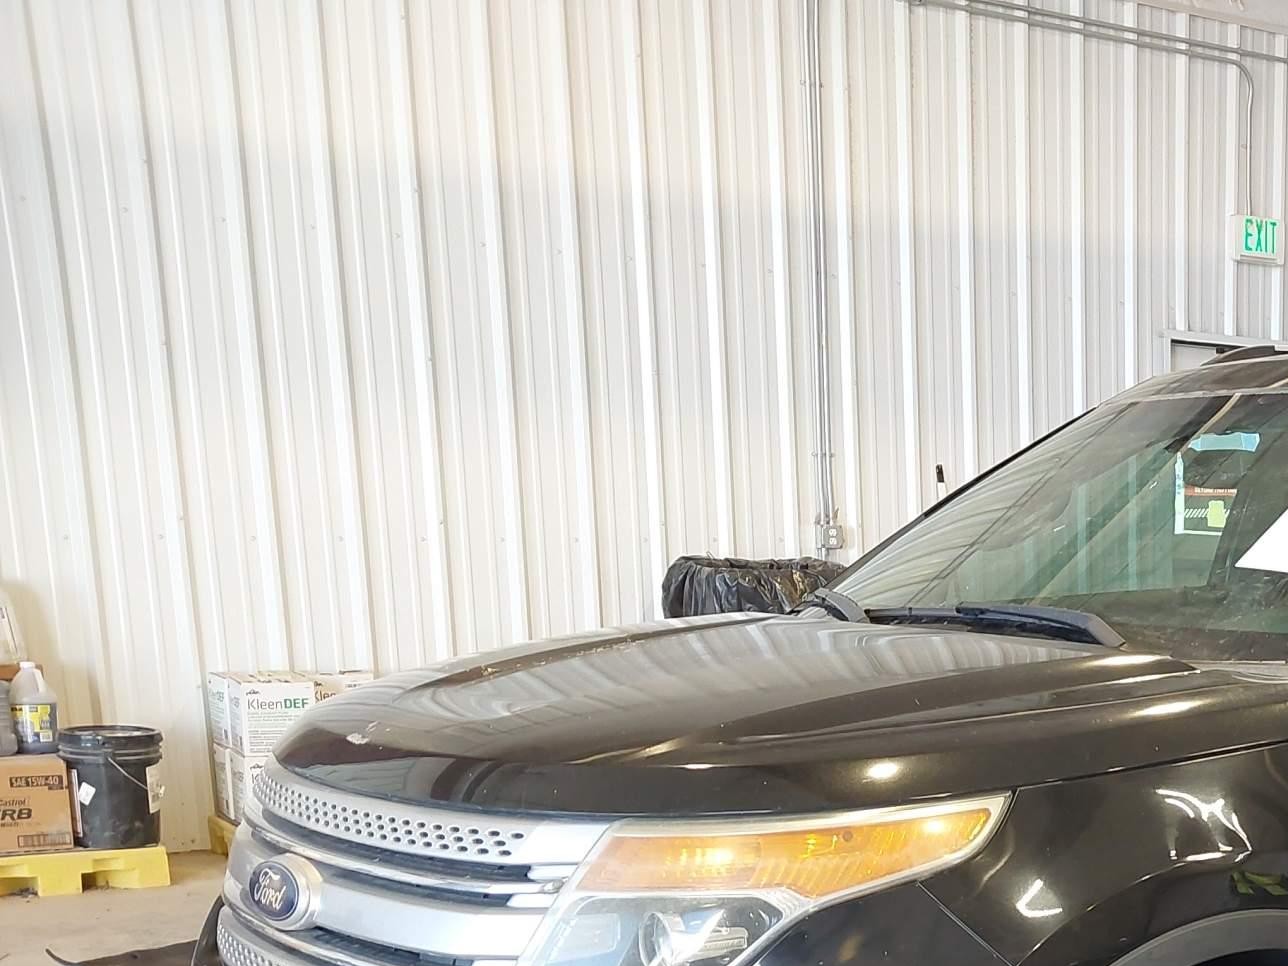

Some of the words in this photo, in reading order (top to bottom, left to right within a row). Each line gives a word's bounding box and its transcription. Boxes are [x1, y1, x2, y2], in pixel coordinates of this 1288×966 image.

[1244, 218, 1277, 254] EXIT
[11, 777, 28, 788] SAE
[28, 775, 60, 787] 15W-40
[0, 807, 33, 821] RB
[253, 867, 288, 911] Ford
